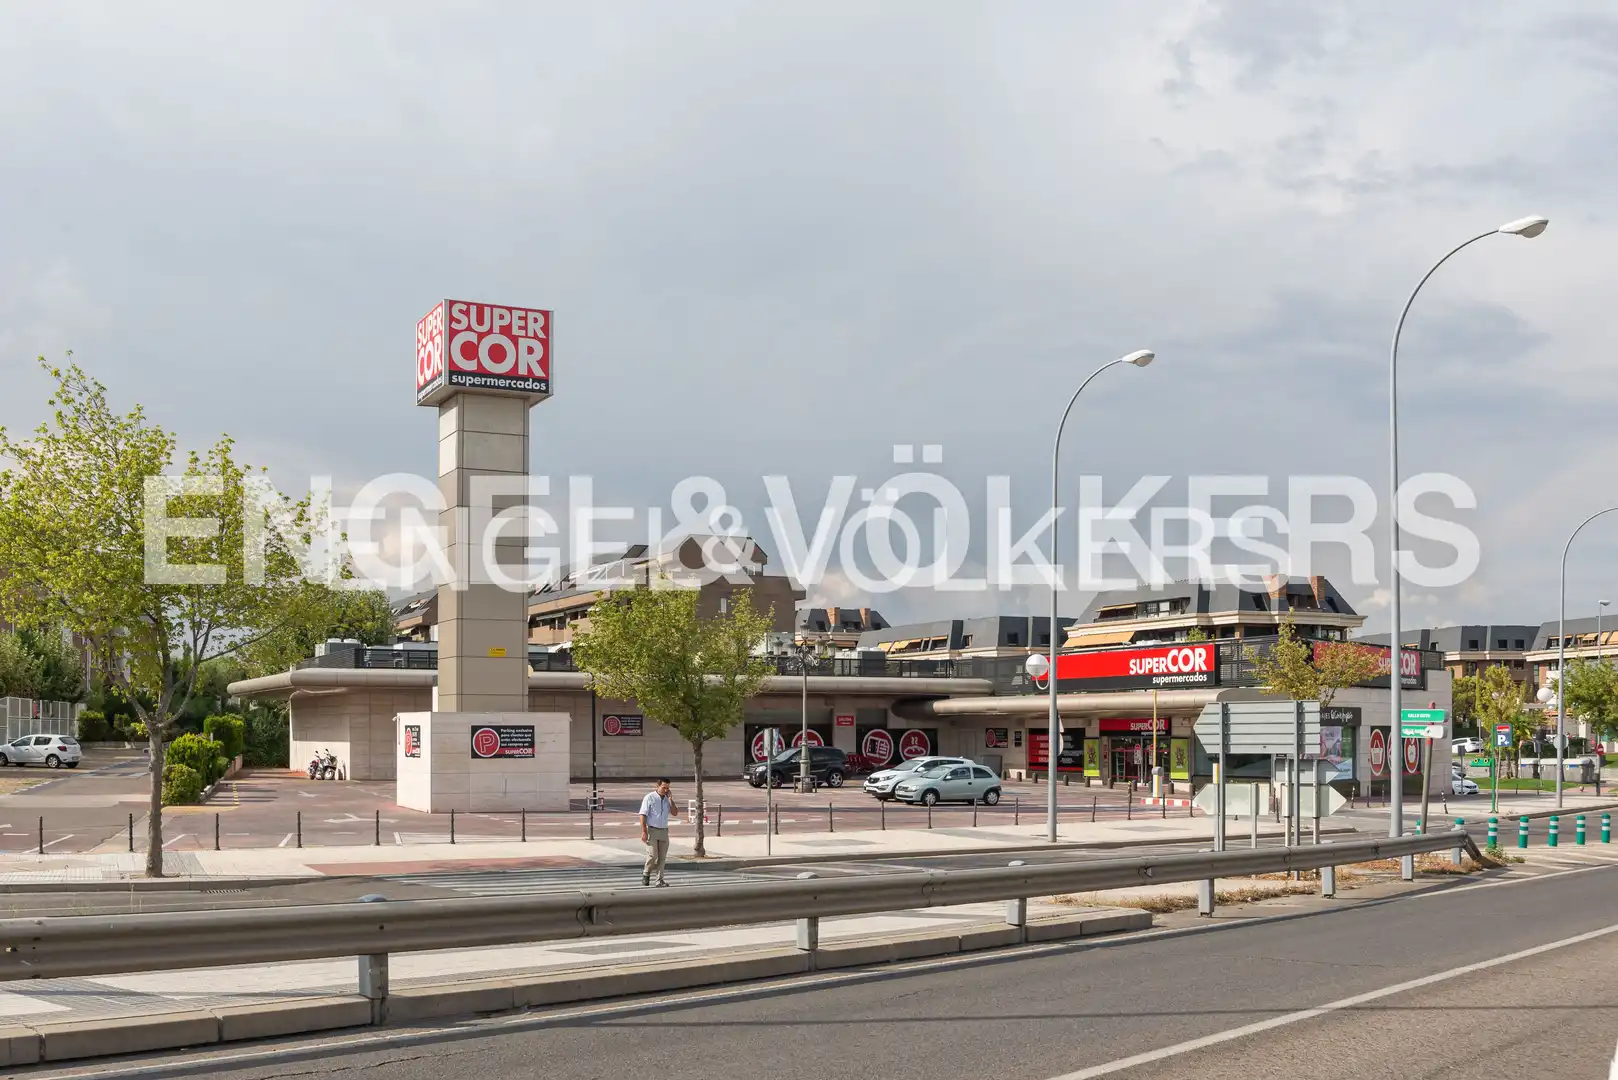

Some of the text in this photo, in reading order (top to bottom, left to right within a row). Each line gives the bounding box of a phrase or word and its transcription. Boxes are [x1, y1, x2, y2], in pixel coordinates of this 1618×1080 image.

[418, 306, 443, 350] SUPER
[451, 303, 546, 338] SUPER
[418, 334, 443, 386] COR
[450, 331, 546, 377] COR
[452, 374, 547, 391] supermercados
[1129, 648, 1207, 675] SUPERCOR
[1152, 672, 1207, 685] supermercados
